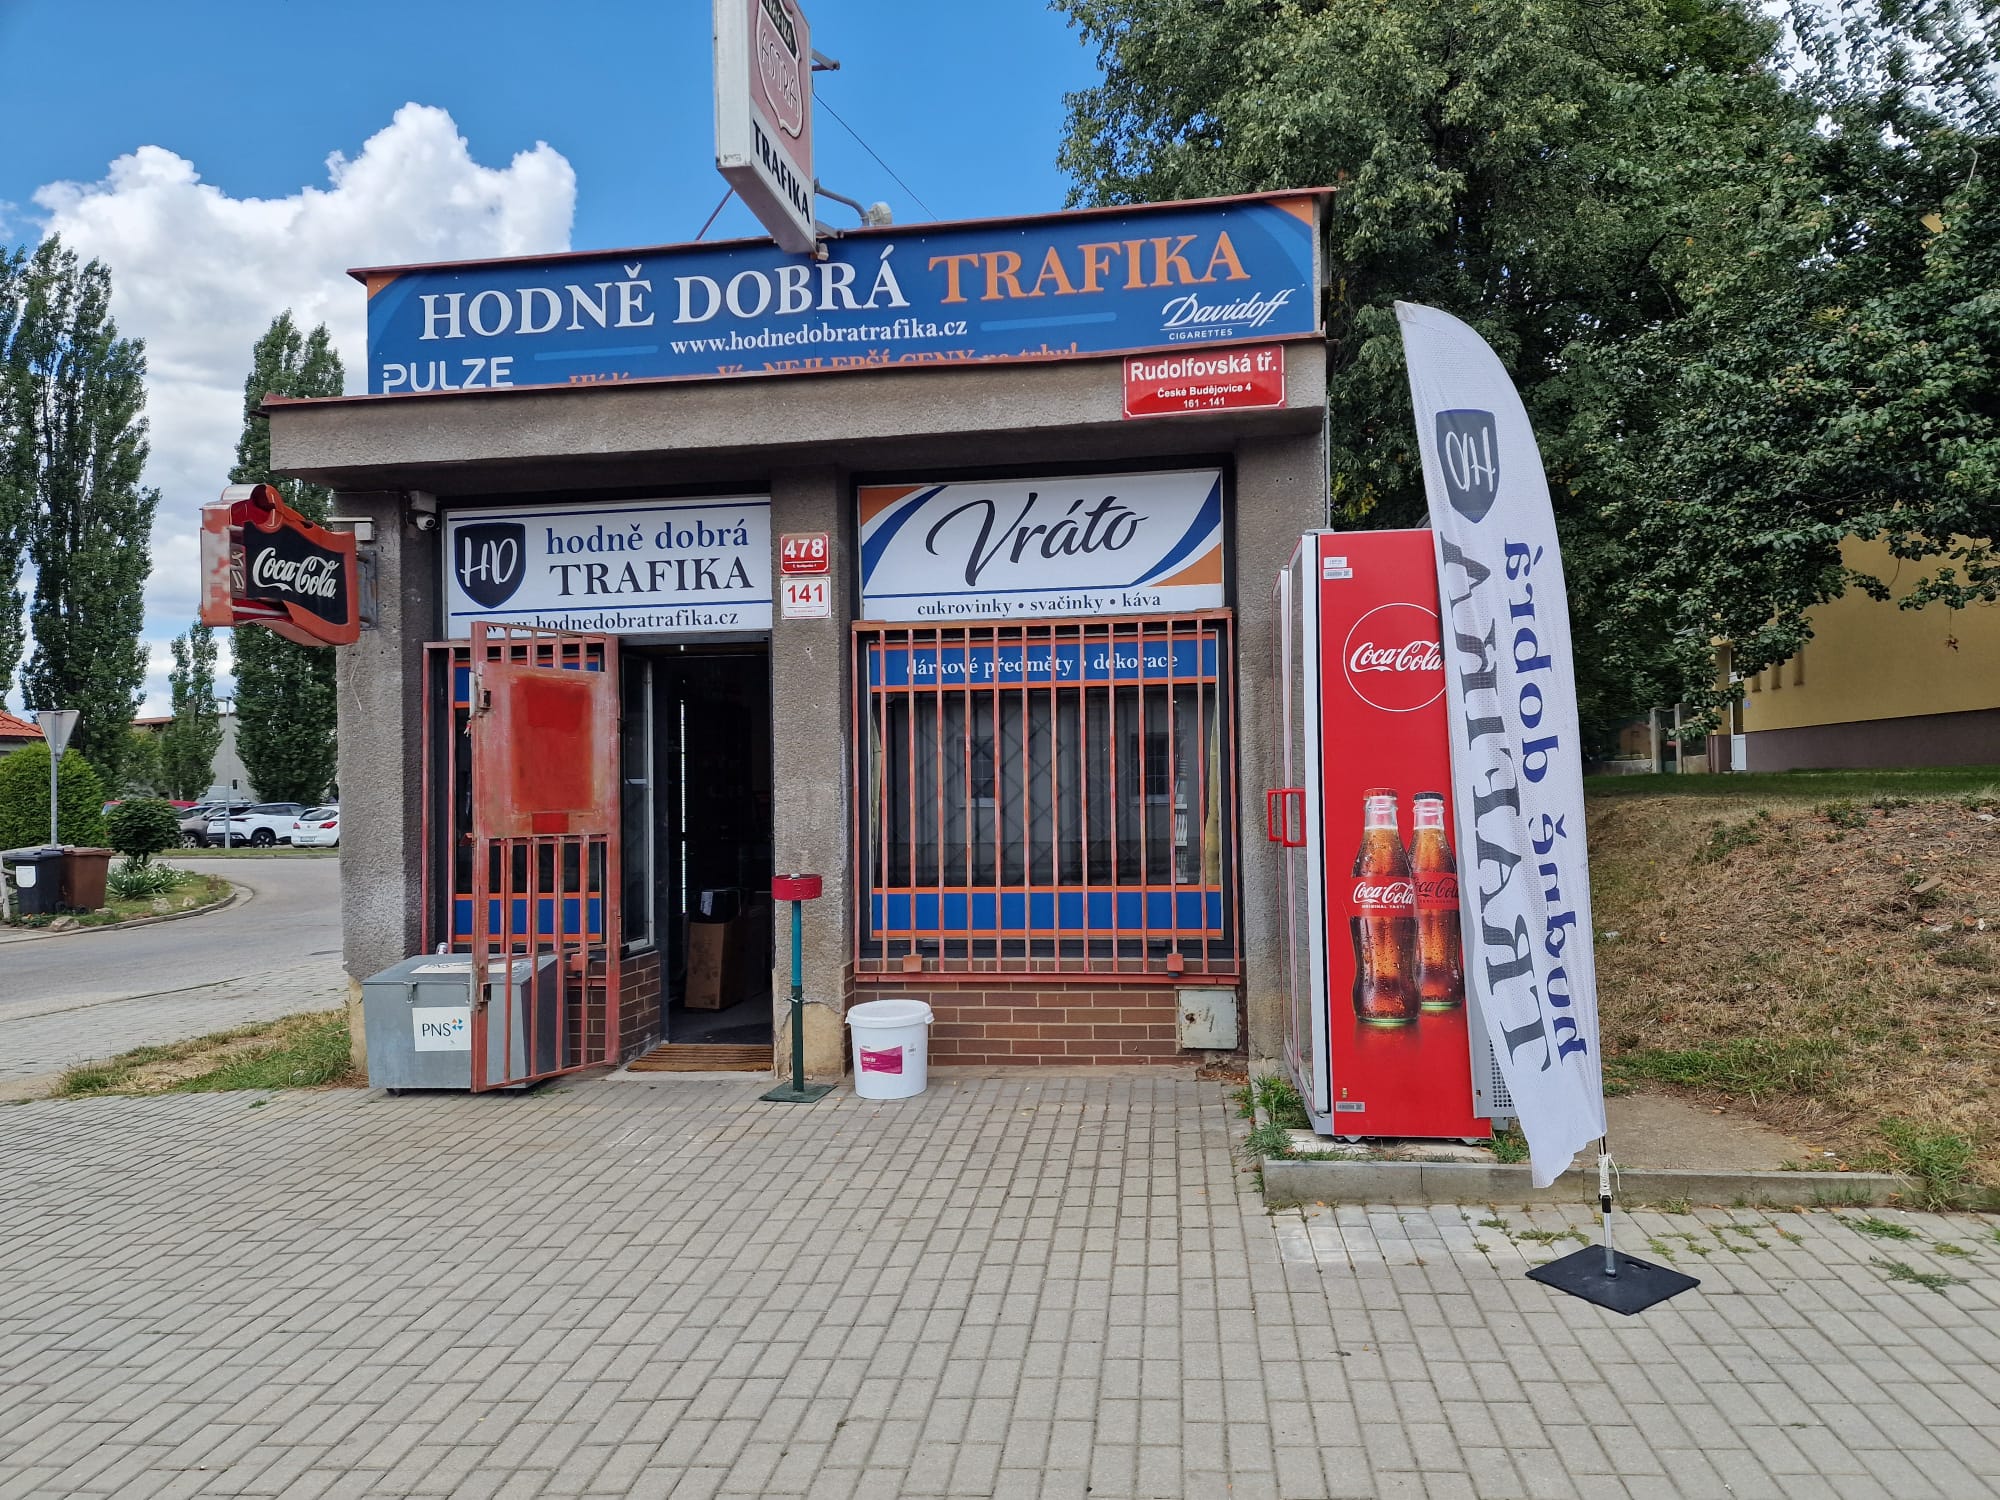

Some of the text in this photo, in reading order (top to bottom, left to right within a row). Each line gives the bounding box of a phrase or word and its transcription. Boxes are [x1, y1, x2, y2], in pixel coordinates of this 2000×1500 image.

[752, 119, 811, 225] TRAFIKA
[418, 230, 1251, 340] HODNĚ DOBRÁ TRAFIKA
[1161, 288, 1296, 328] Davidoff
[670, 317, 968, 355] www.hodnedobratrafika.cz
[1169, 328, 1233, 340] CIGARETTES
[383, 356, 514, 395] PULZE
[1130, 351, 1277, 382] Rudolfovská tř.
[1157, 383, 1252, 398] České Budějovice 4
[1183, 399, 1199, 408] 161
[1209, 397, 1226, 406] 141
[545, 518, 750, 555] hodně dobrá
[784, 538, 824, 558] 478
[926, 492, 1150, 587] Vráto
[252, 547, 340, 598] Coca-Cola
[459, 536, 518, 588] HD
[549, 556, 754, 596] TRAFIKA
[787, 584, 823, 604] 141
[917, 592, 1161, 617] cukrovinky svačinky káva
[487, 609, 739, 633] wwhodnedobratrafika.cz
[1350, 640, 1442, 673] Coca-Cola
[1353, 881, 1415, 904] Coca-Cola
[422, 1022, 452, 1037] PNS
